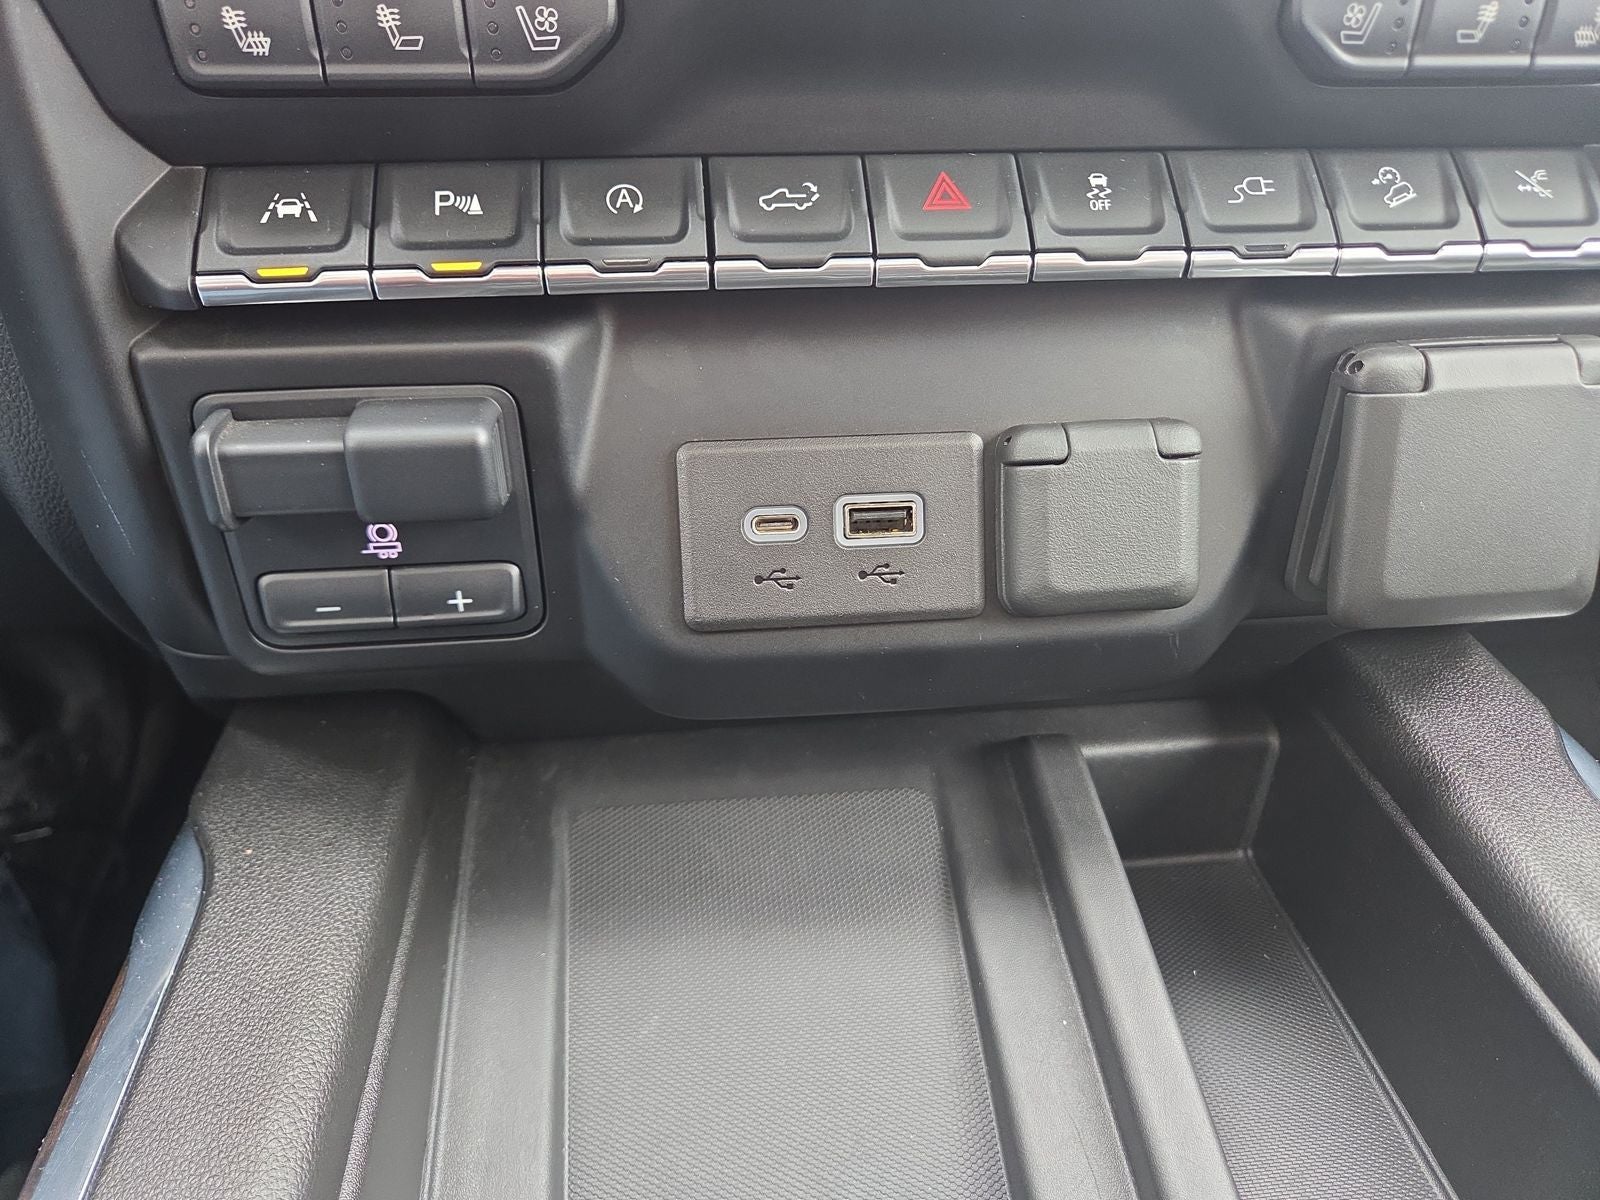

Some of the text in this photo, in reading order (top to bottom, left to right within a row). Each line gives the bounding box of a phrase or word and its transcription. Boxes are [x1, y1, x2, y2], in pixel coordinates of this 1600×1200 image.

[434, 190, 455, 216] P
[615, 188, 634, 208] A
[1089, 199, 1112, 211] OFF
